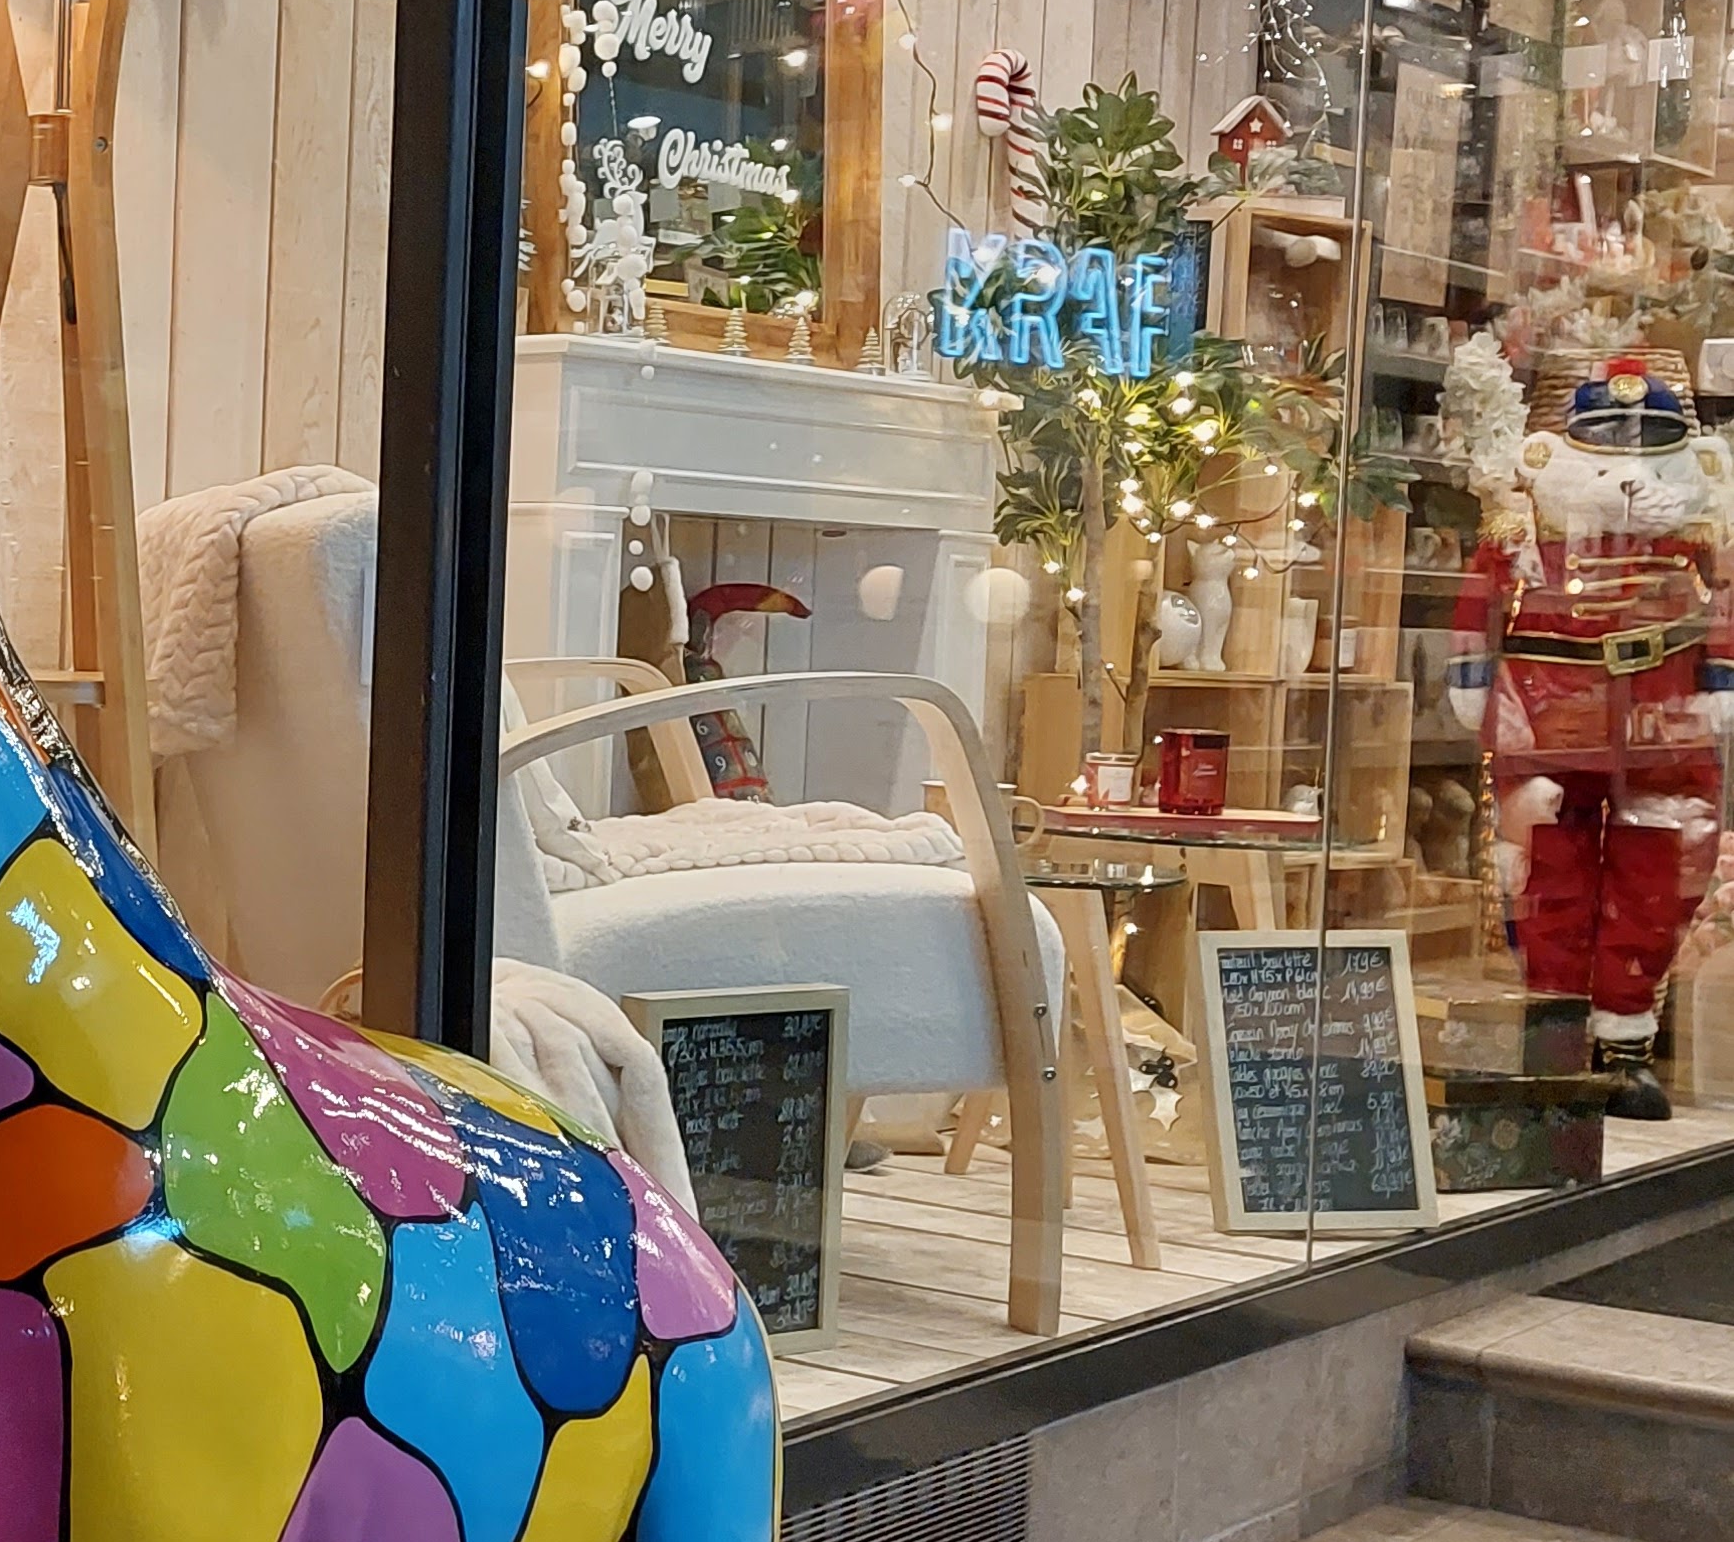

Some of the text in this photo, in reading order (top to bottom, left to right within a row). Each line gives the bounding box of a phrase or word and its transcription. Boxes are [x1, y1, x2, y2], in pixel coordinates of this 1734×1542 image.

[657, 127, 792, 197] Christmas
[696, 719, 709, 736] 6
[714, 755, 727, 773] 9
